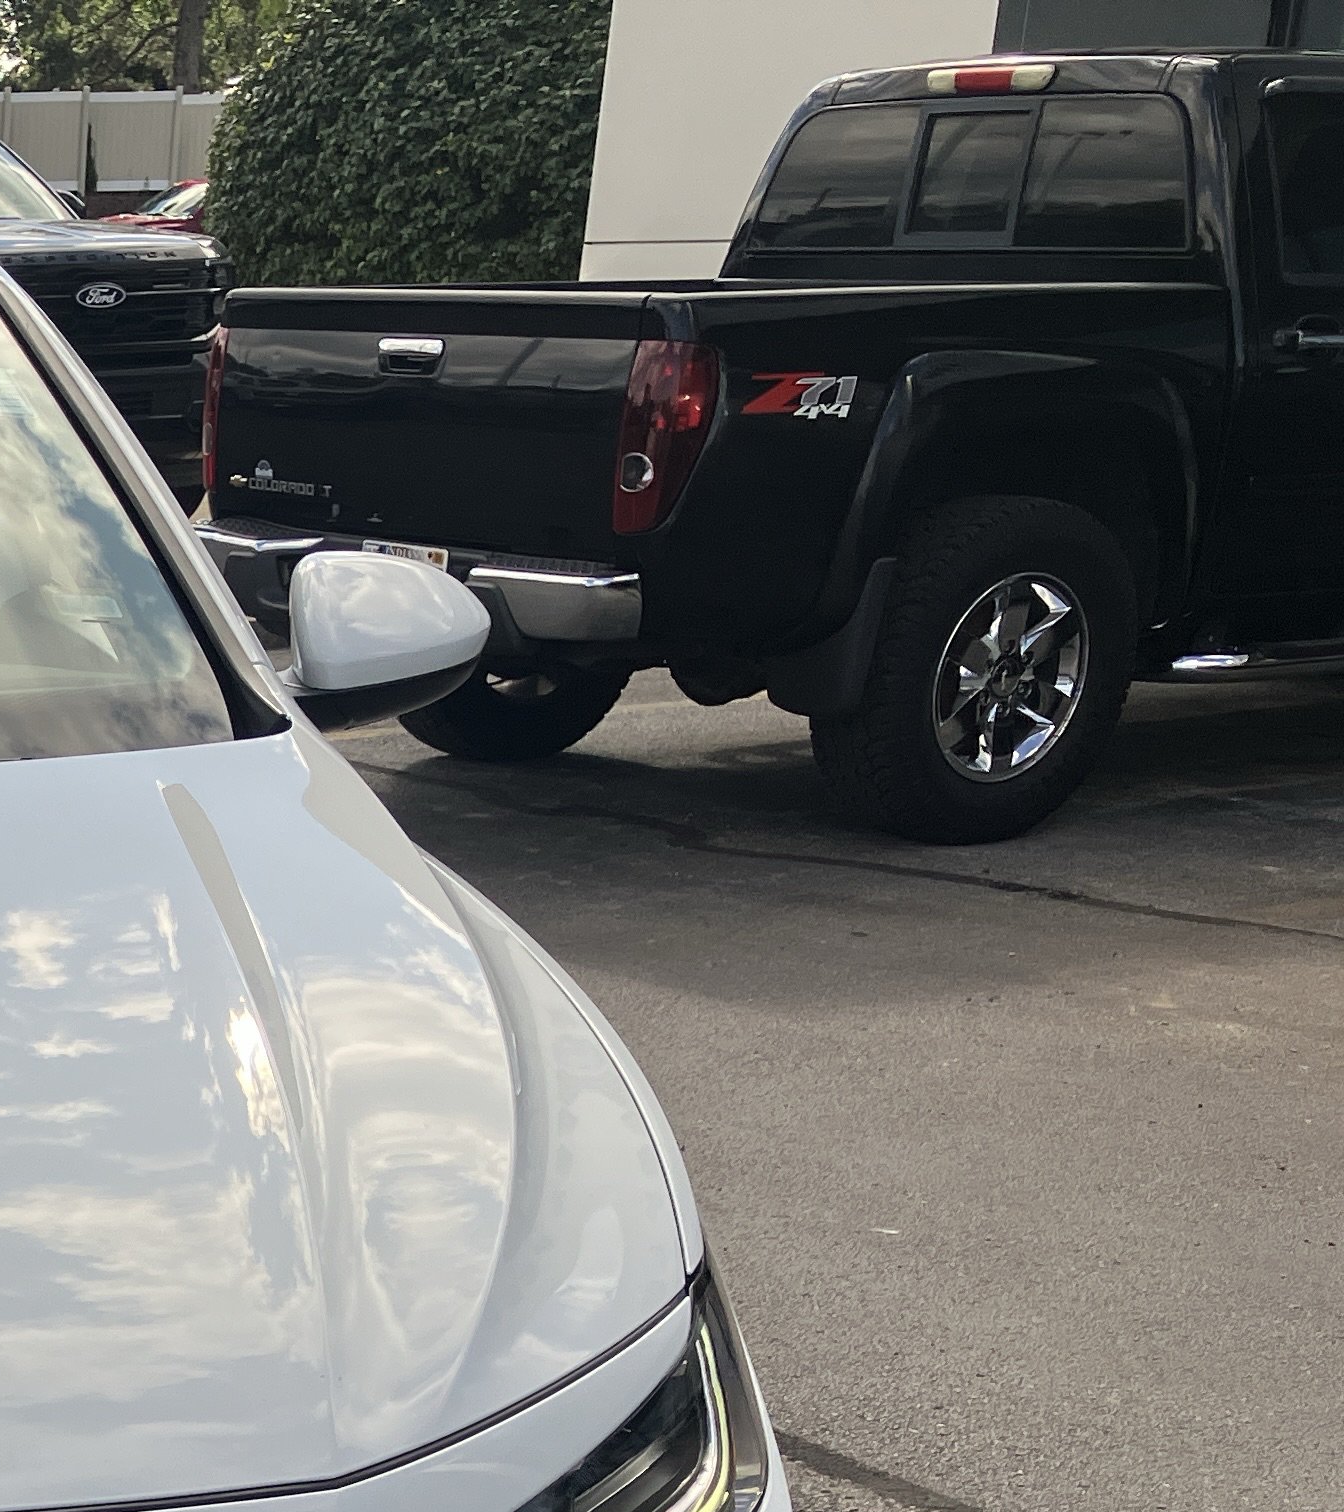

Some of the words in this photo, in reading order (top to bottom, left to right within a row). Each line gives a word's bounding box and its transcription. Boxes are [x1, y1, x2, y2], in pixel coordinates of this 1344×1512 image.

[85, 288, 118, 305] Ford
[740, 371, 859, 417] Z71
[248, 477, 315, 497] COLORADO
